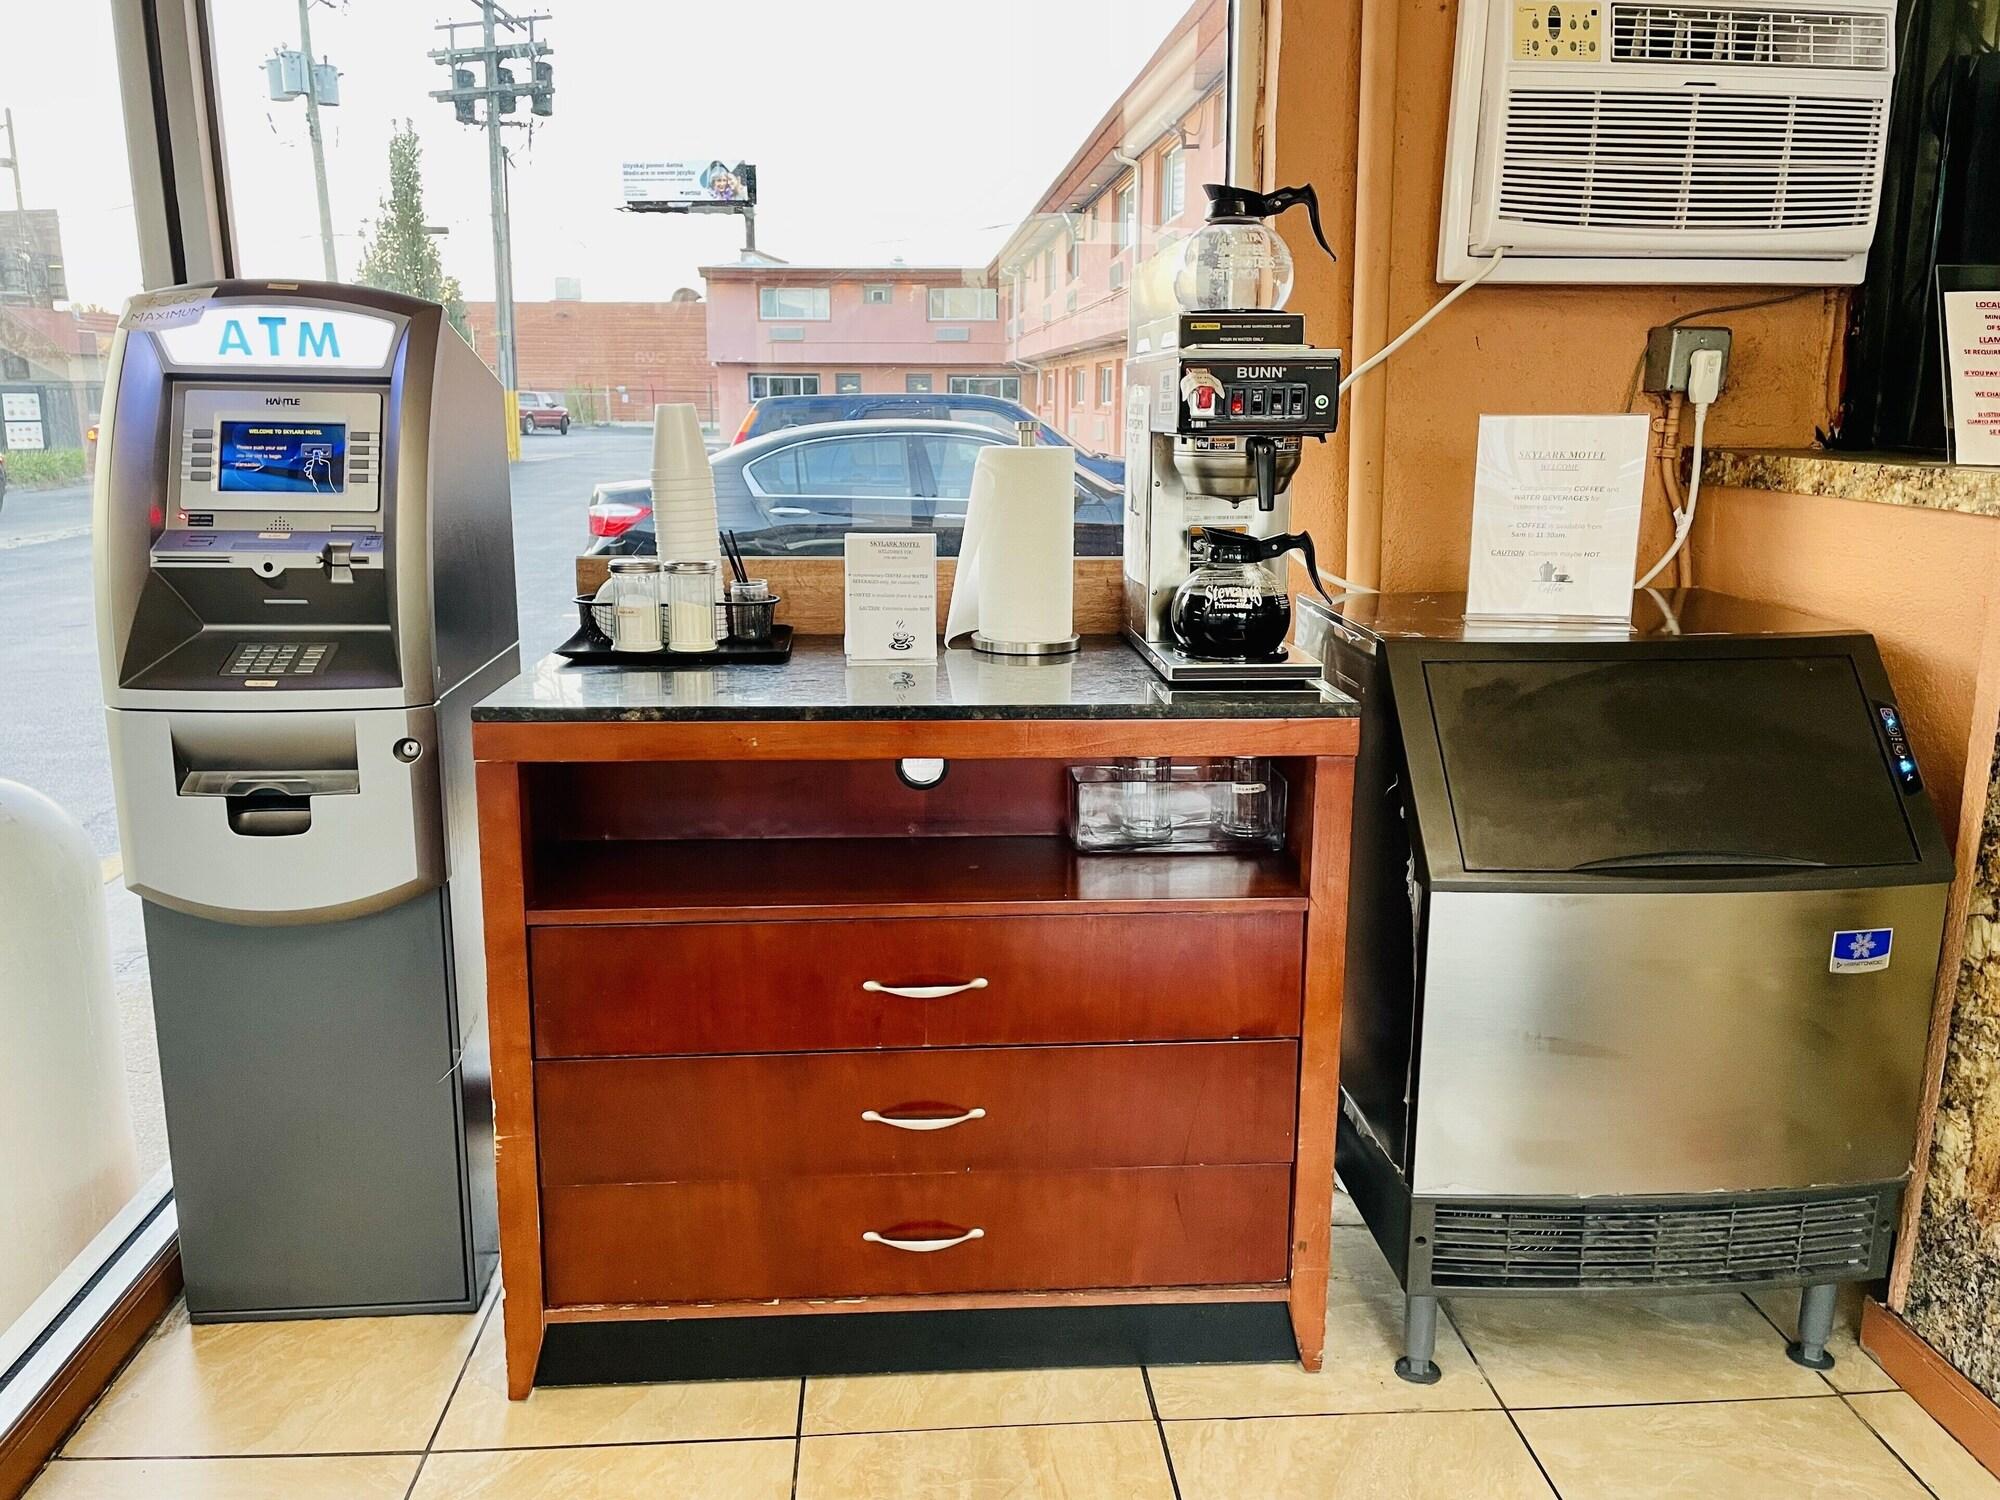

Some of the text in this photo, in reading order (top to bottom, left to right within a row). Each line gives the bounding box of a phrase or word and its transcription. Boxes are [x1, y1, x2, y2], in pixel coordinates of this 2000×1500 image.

[130, 306, 205, 322] MAXIMUM
[218, 316, 341, 359] ATM
[1236, 366, 1283, 379] BUNN
[265, 397, 301, 407] HANTLE
[1519, 450, 1606, 460] SKYLARK MOTEL
[1540, 463, 1580, 471] WELCOME
[1574, 485, 1606, 493] COFFEE
[1513, 494, 1541, 502] WATER
[1542, 494, 1590, 502] BEVERAGES
[1516, 521, 1546, 529] COFFEE
[1511, 531, 1526, 539] 5am
[869, 541, 921, 549] SKYLARK MOTEL
